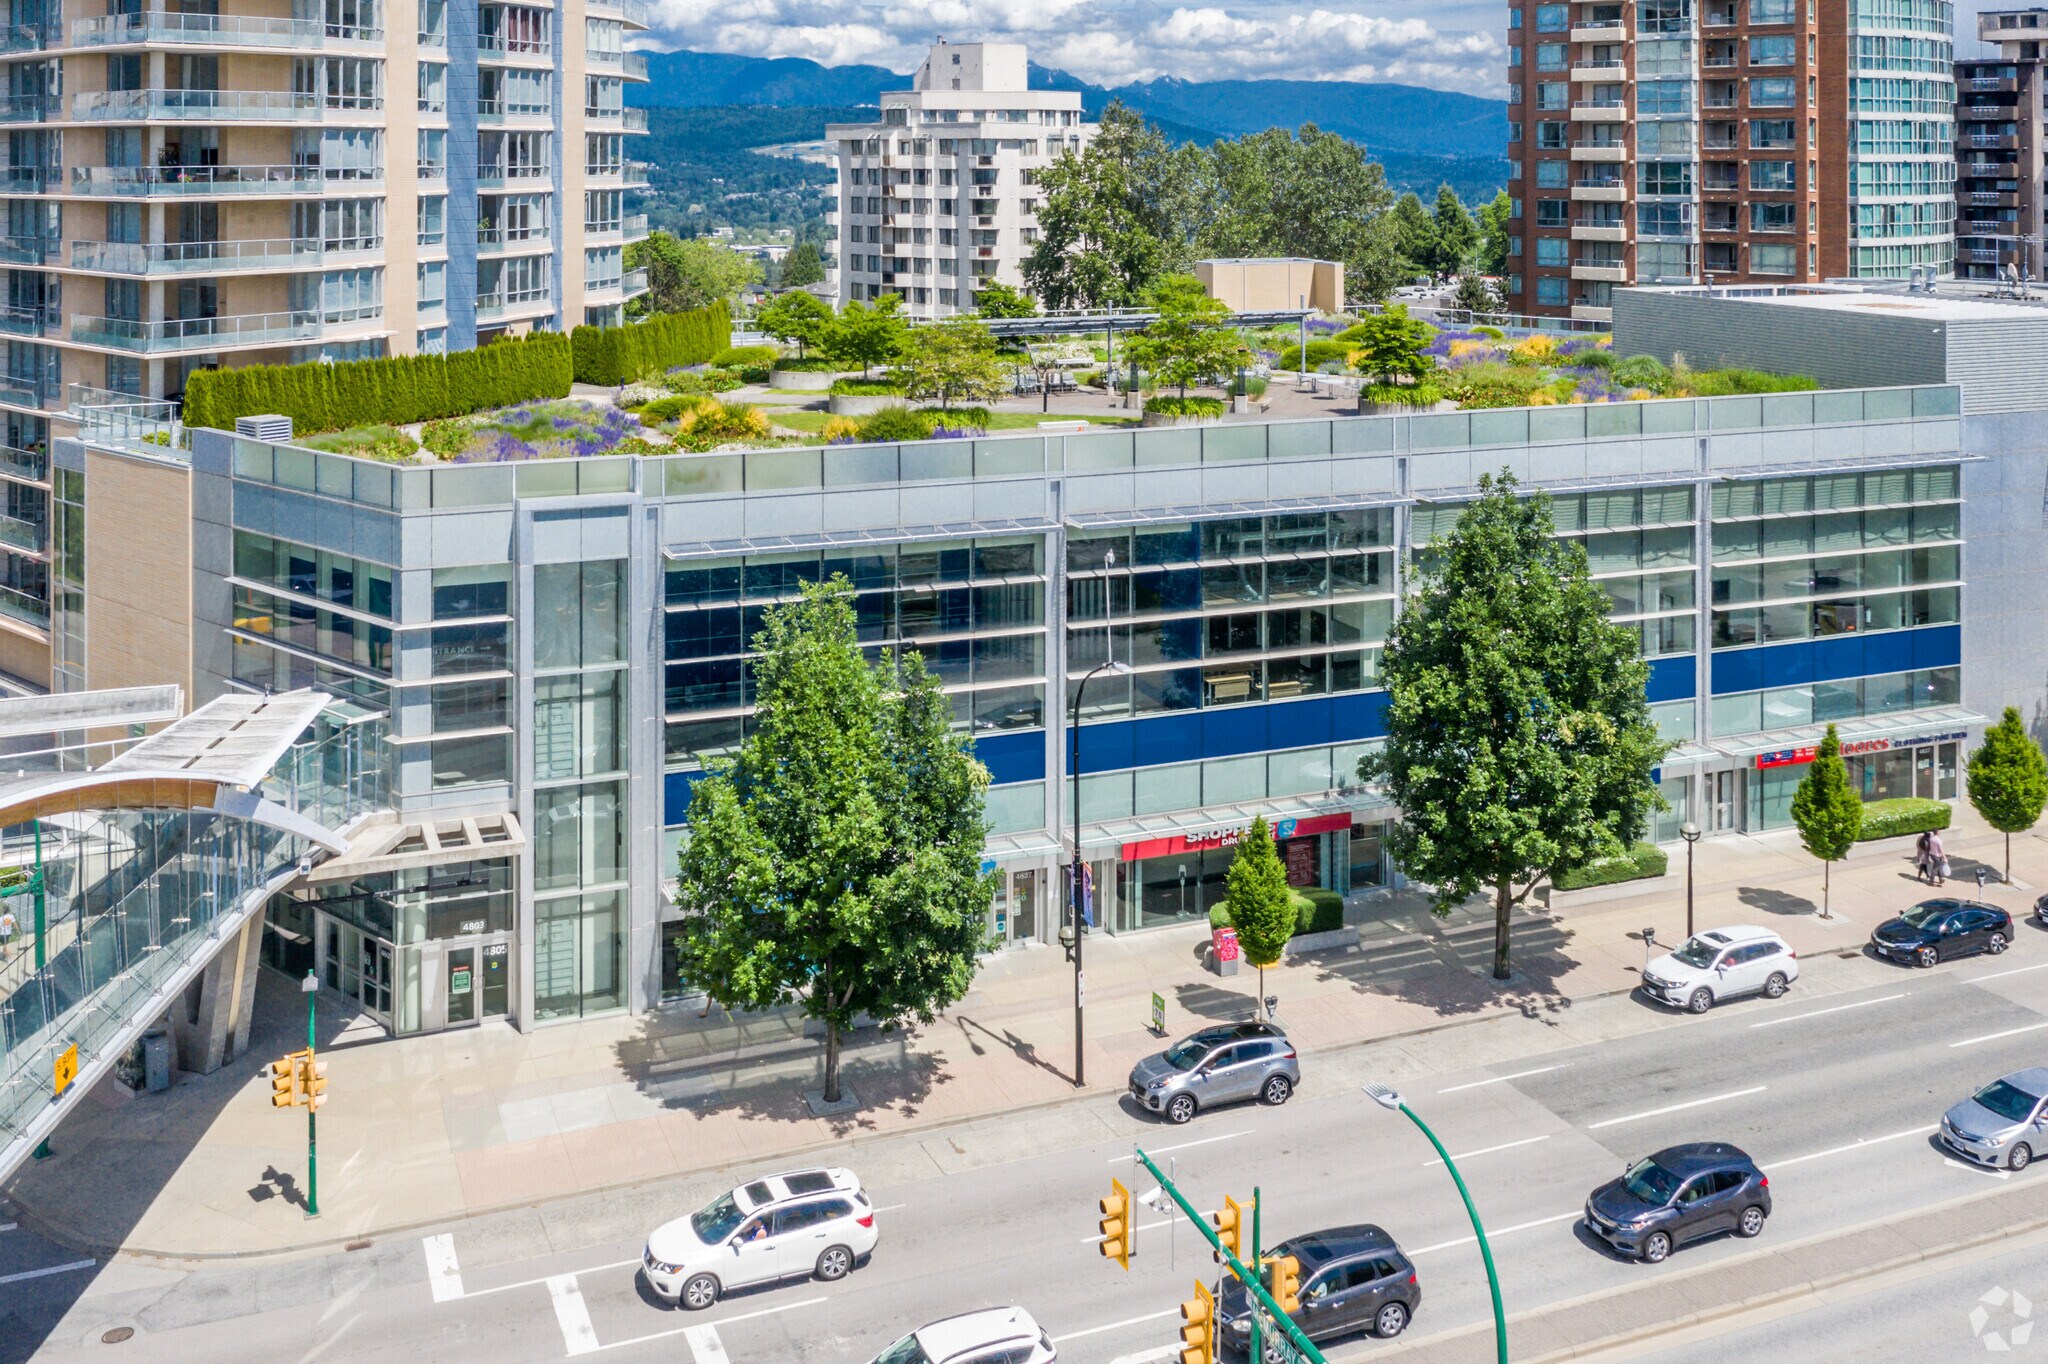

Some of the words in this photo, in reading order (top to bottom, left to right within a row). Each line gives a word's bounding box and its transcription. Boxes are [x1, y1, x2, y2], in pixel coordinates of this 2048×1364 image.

[433, 645, 475, 655] NTRANCE
[1894, 736, 1933, 747] CLOTHING
[1934, 734, 1949, 742] FOR
[1951, 731, 1967, 740] MEN
[1184, 821, 1276, 843] SHOPPES
[462, 920, 485, 931] 4803
[483, 944, 507, 956] 4805
